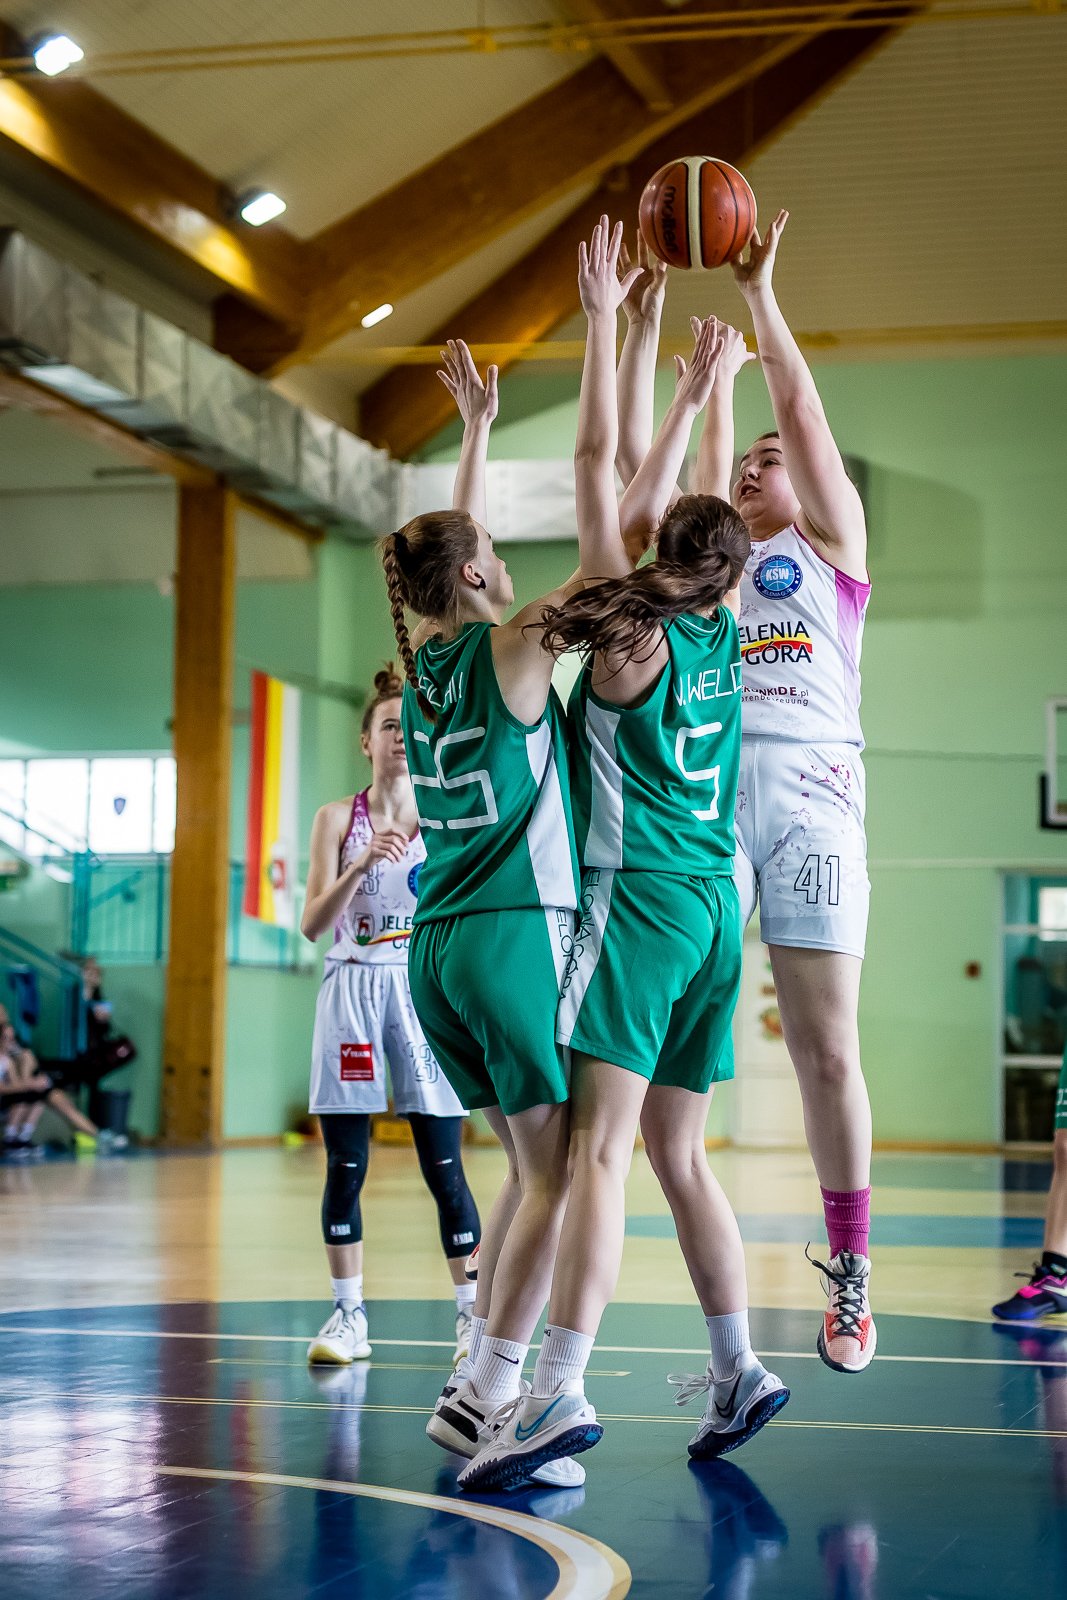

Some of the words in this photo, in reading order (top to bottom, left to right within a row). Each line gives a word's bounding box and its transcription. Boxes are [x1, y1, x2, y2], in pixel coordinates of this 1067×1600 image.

[765, 568, 789, 581] KSW
[738, 621, 810, 644] ELENIA
[745, 641, 812, 665] GÓRA
[411, 726, 499, 829] 25
[674, 721, 722, 821] 5
[793, 854, 840, 906] 41
[380, 915, 414, 932] JELE
[576, 869, 600, 943] ELONA
